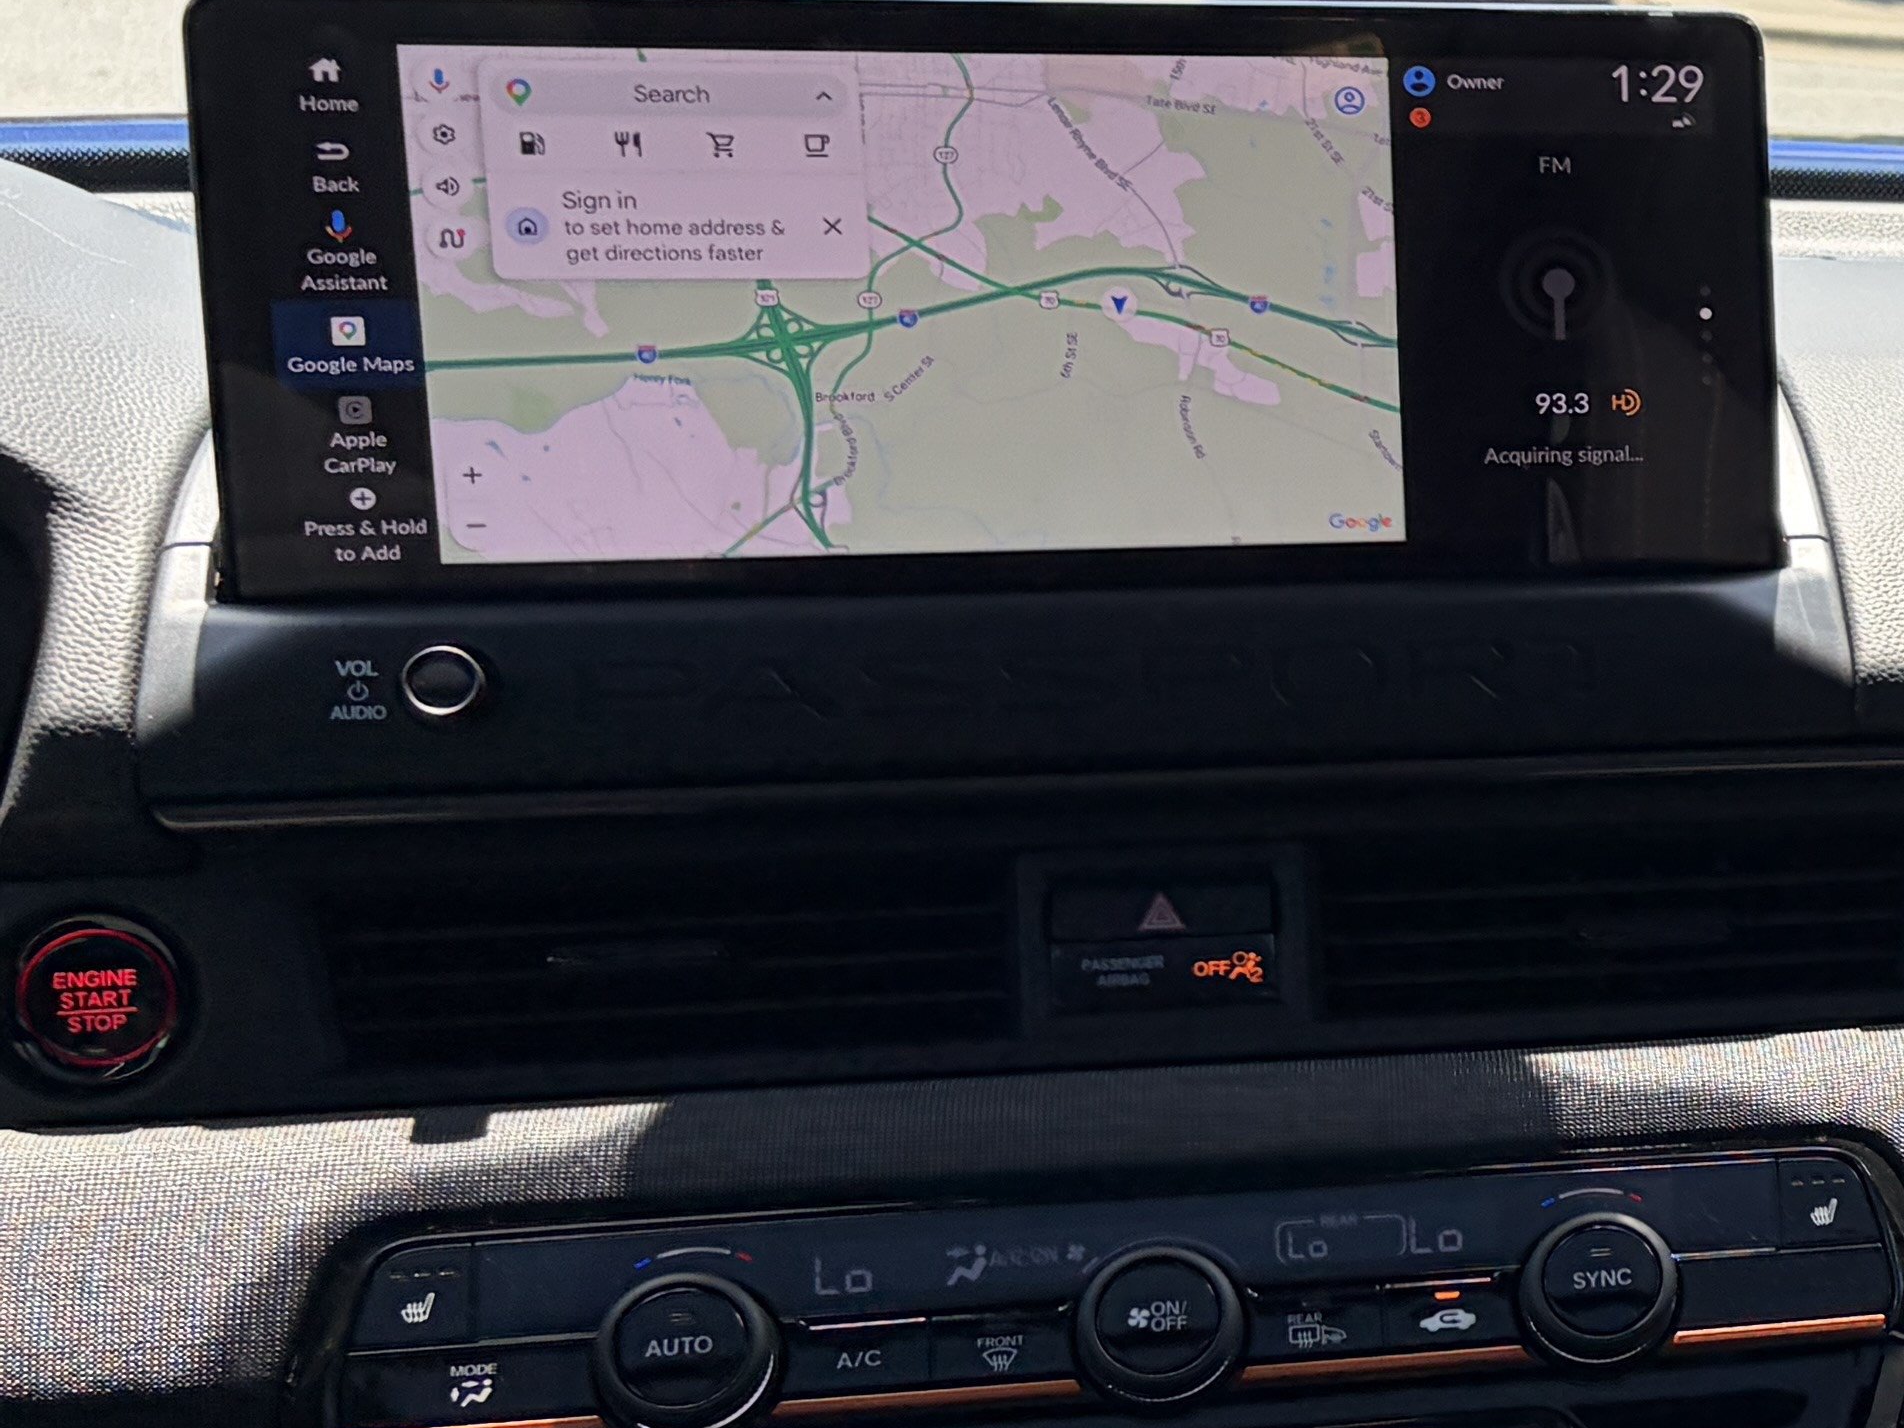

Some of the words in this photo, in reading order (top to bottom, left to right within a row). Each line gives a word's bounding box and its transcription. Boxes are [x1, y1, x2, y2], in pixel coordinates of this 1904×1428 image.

[1446, 75, 1505, 92] Owner
[1611, 64, 1705, 104] 1:29
[299, 94, 360, 113] Home
[634, 84, 711, 104] Search
[1538, 156, 1573, 175] FM
[312, 175, 360, 193] Back
[562, 189, 612, 215] Sign
[617, 189, 638, 210] in
[565, 220, 586, 236] to
[590, 220, 622, 236] set
[627, 218, 683, 236] home
[687, 218, 766, 236] address
[770, 219, 786, 236] &
[306, 248, 379, 269] Google
[566, 246, 600, 266] get
[604, 244, 703, 262] directions
[708, 243, 765, 262] faster
[300, 274, 390, 292] Assistant
[287, 356, 359, 375] Google
[362, 357, 416, 375] Maps
[816, 391, 877, 404] Brookford
[1534, 393, 1591, 416] 93.3
[330, 431, 389, 451] Apple
[323, 456, 397, 476] CarPlay
[1484, 447, 1574, 467] Acquiring
[1578, 445, 1644, 466] signal...
[303, 520, 357, 537] Press
[360, 519, 378, 536] &
[381, 517, 429, 535] Hold
[1329, 513, 1393, 532] Google
[335, 546, 357, 562] to
[361, 543, 402, 562] Add
[334, 659, 381, 678] VOL
[572, 640, 1598, 724] PASSPORT
[329, 704, 388, 721] AUDIO
[1192, 959, 1232, 979] OFF
[52, 968, 139, 991] ENGINE
[59, 988, 133, 1010] START
[67, 1013, 129, 1034] STOP
[1572, 1267, 1633, 1290] SYNC
[1150, 1300, 1189, 1317] ON/
[1286, 1312, 1322, 1324] REAR
[1150, 1315, 1188, 1332] OFF
[644, 1335, 714, 1359] AUTO
[976, 1334, 1024, 1349] FRONT
[835, 1348, 883, 1371] A/C
[449, 1362, 498, 1378] MODE
